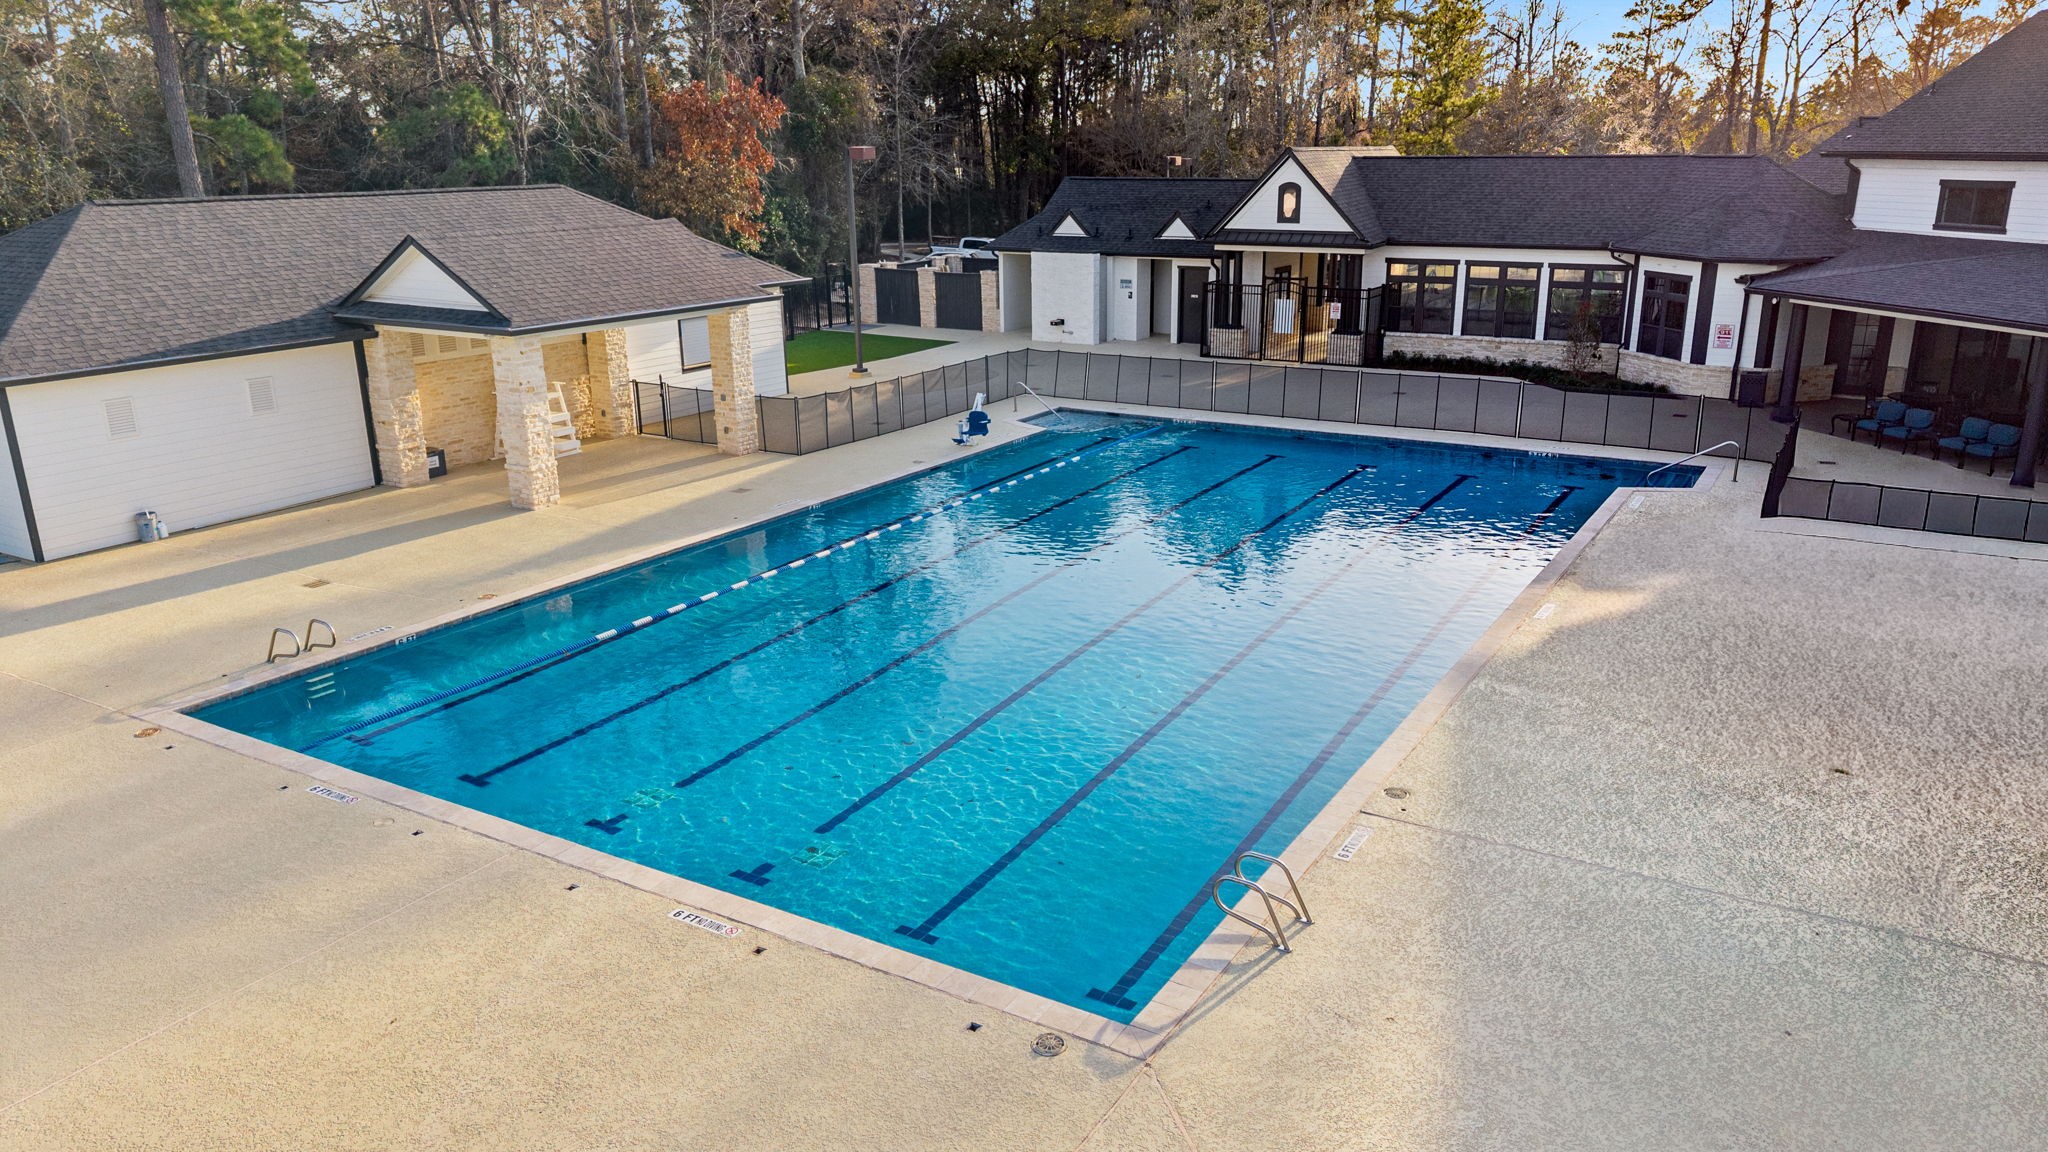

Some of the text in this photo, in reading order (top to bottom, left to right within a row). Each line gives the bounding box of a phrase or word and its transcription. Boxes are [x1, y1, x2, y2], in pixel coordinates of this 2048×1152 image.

[1341, 844, 1356, 854] FT
[672, 910, 685, 918] 6
[682, 913, 701, 923] FT
